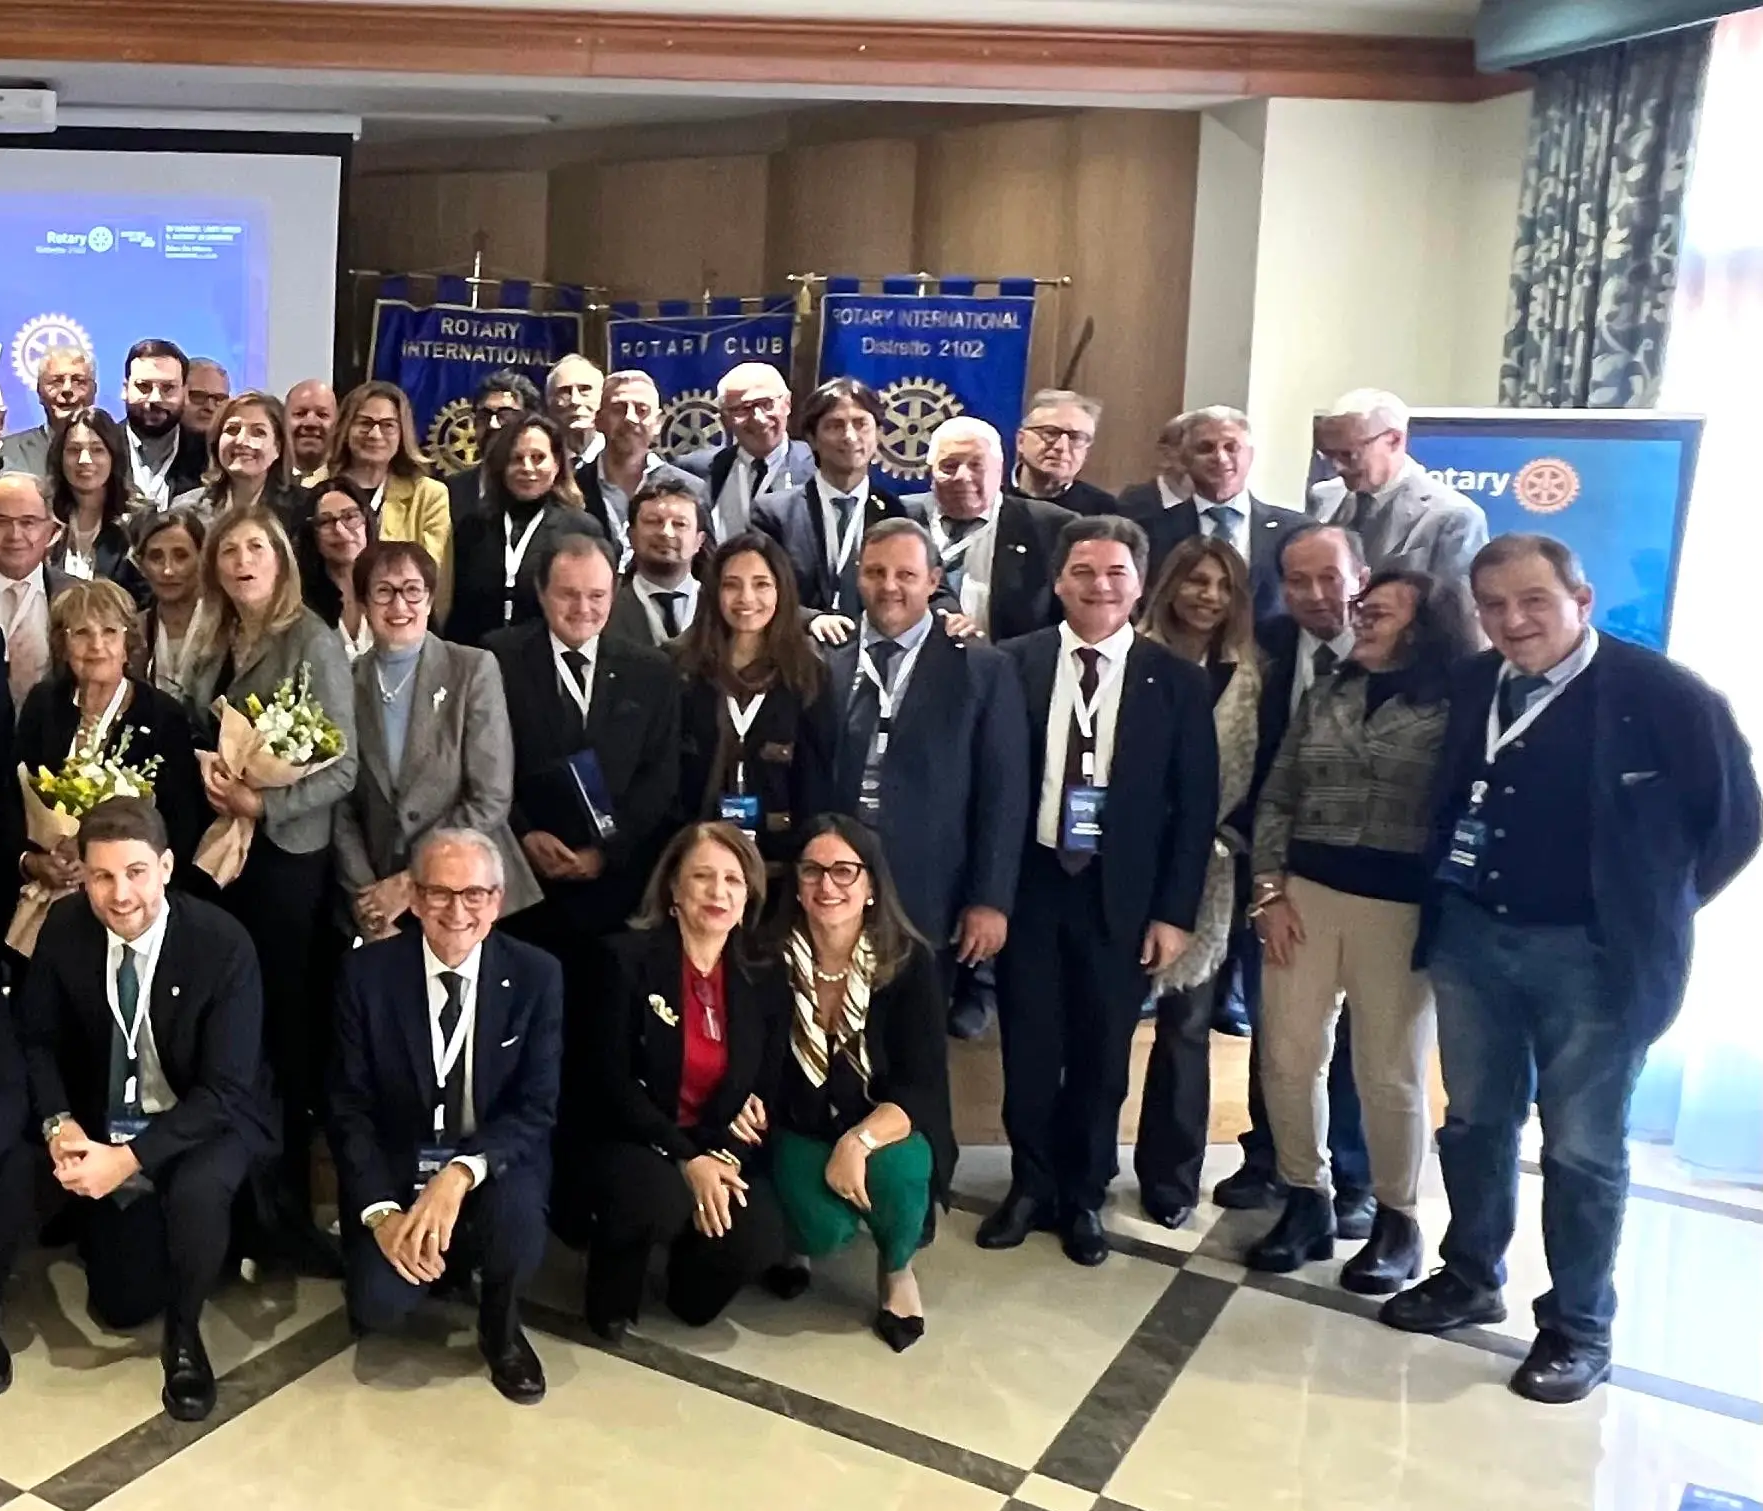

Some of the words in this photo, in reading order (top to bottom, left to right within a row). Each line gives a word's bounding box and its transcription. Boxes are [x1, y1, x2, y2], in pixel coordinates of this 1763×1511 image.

[440, 316, 521, 341] ROTARY
[833, 308, 894, 327] ROTARY
[898, 309, 1022, 330] INTERNATIONAL
[401, 339, 555, 367] INTERNATIONAL
[620, 333, 710, 361] ROTARY
[723, 336, 784, 356] CLUB
[861, 336, 932, 357] Distretto
[938, 338, 986, 359] 2102
[1426, 467, 1511, 497] otary
